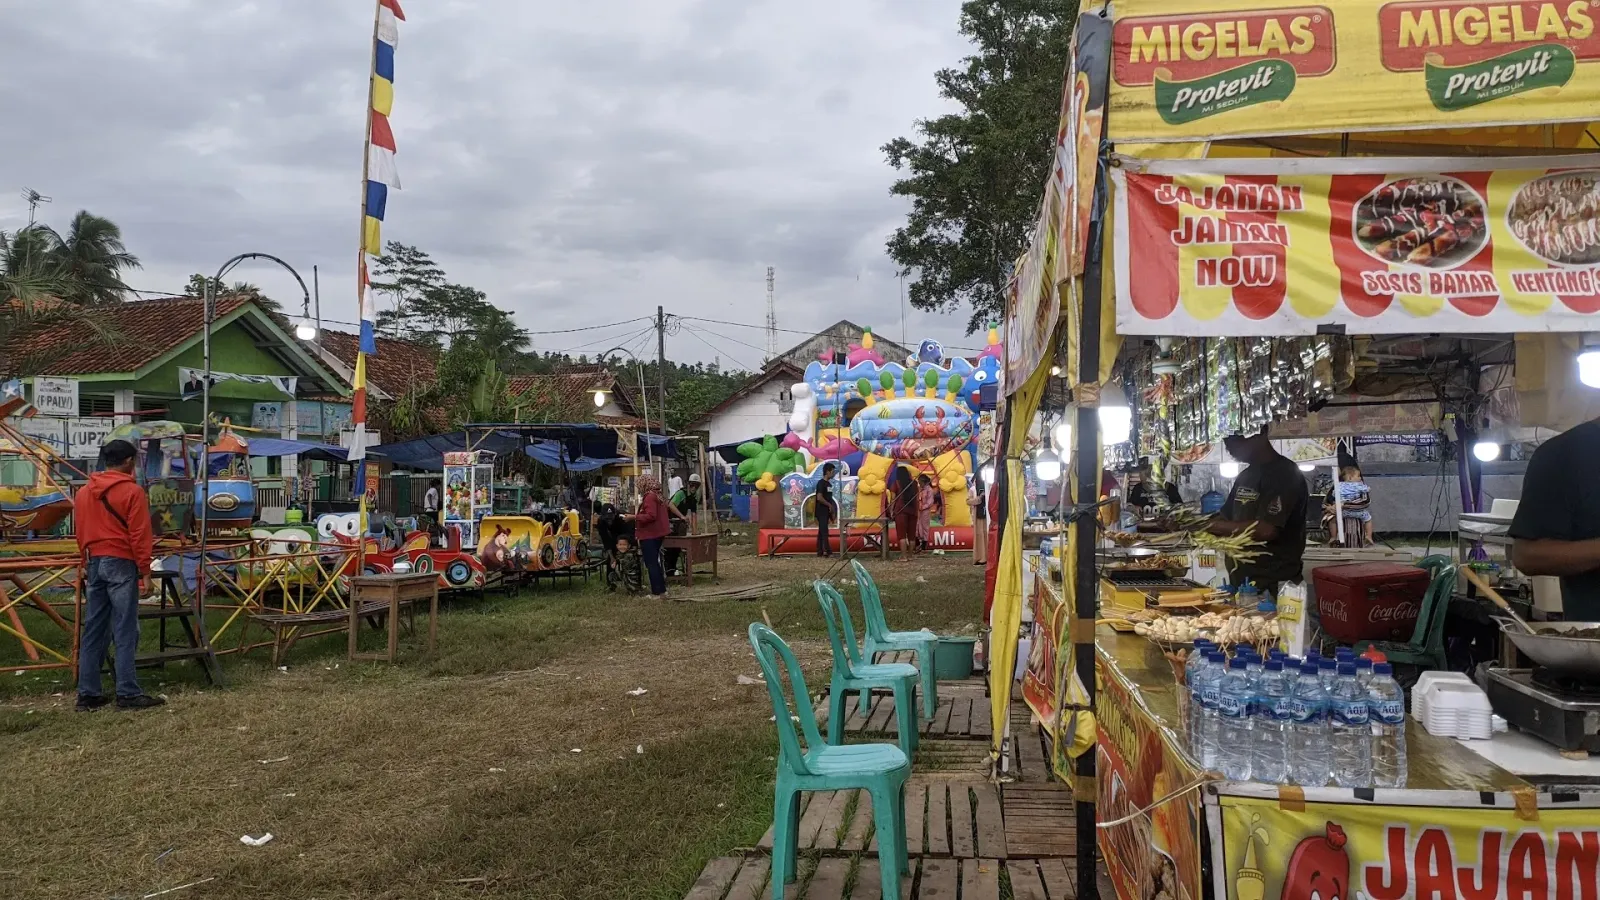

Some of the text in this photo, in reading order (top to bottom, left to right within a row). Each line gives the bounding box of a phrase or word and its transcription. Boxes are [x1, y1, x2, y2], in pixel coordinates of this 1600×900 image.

[1129, 15, 1316, 63] MIGELAS
[1398, 1, 1594, 49] MIGELAS
[1171, 66, 1276, 113] Protevit
[1444, 51, 1552, 99] Protevit
[1216, 95, 1249, 110] SEDUH
[1155, 184, 1305, 212] JAJANAN
[1171, 216, 1290, 247] JAMAN
[1196, 256, 1277, 287] NOW
[1362, 271, 1498, 295] SOSIS BAKAR
[1511, 269, 1592, 294] KENTANG
